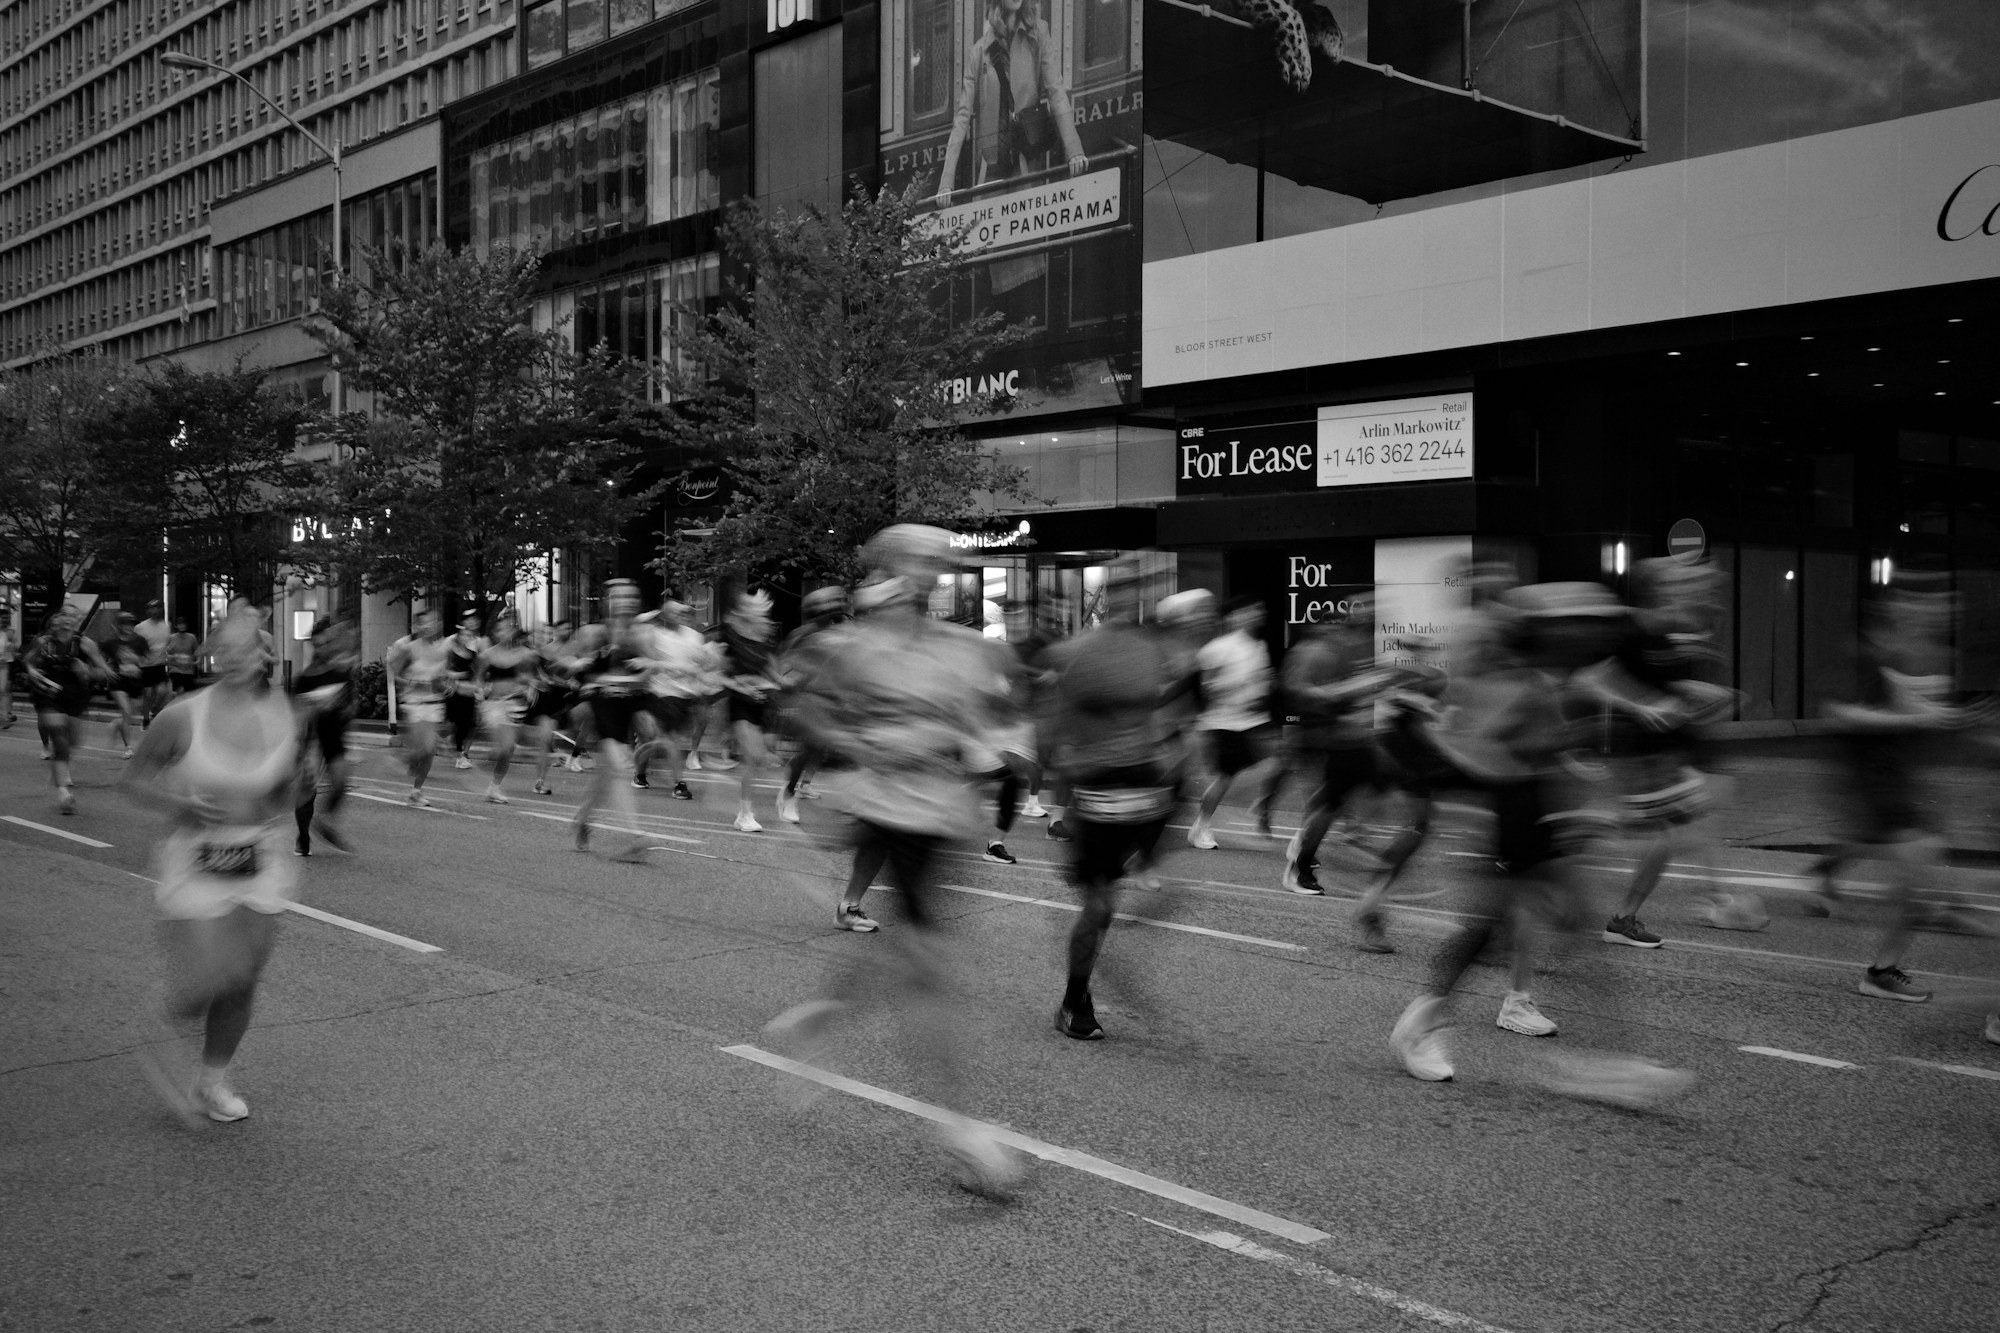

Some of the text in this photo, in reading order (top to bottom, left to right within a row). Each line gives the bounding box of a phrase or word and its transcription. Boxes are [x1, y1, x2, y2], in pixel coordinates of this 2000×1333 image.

[939, 188, 1075, 229] RIDE THE MONTBLANC
[979, 223, 1001, 242] OF
[1175, 332, 1273, 354] BLOOR STREET WEST
[1100, 372, 1132, 384] Let's Write
[1442, 401, 1467, 413] Retail
[1181, 427, 1205, 438] CBRE
[1359, 424, 1390, 439] Arlin
[1181, 440, 1312, 480] For Lease
[1323, 438, 1466, 467] +1 416 362 2244
[1288, 556, 1332, 587] For
[1380, 623, 1405, 634] Arlin
